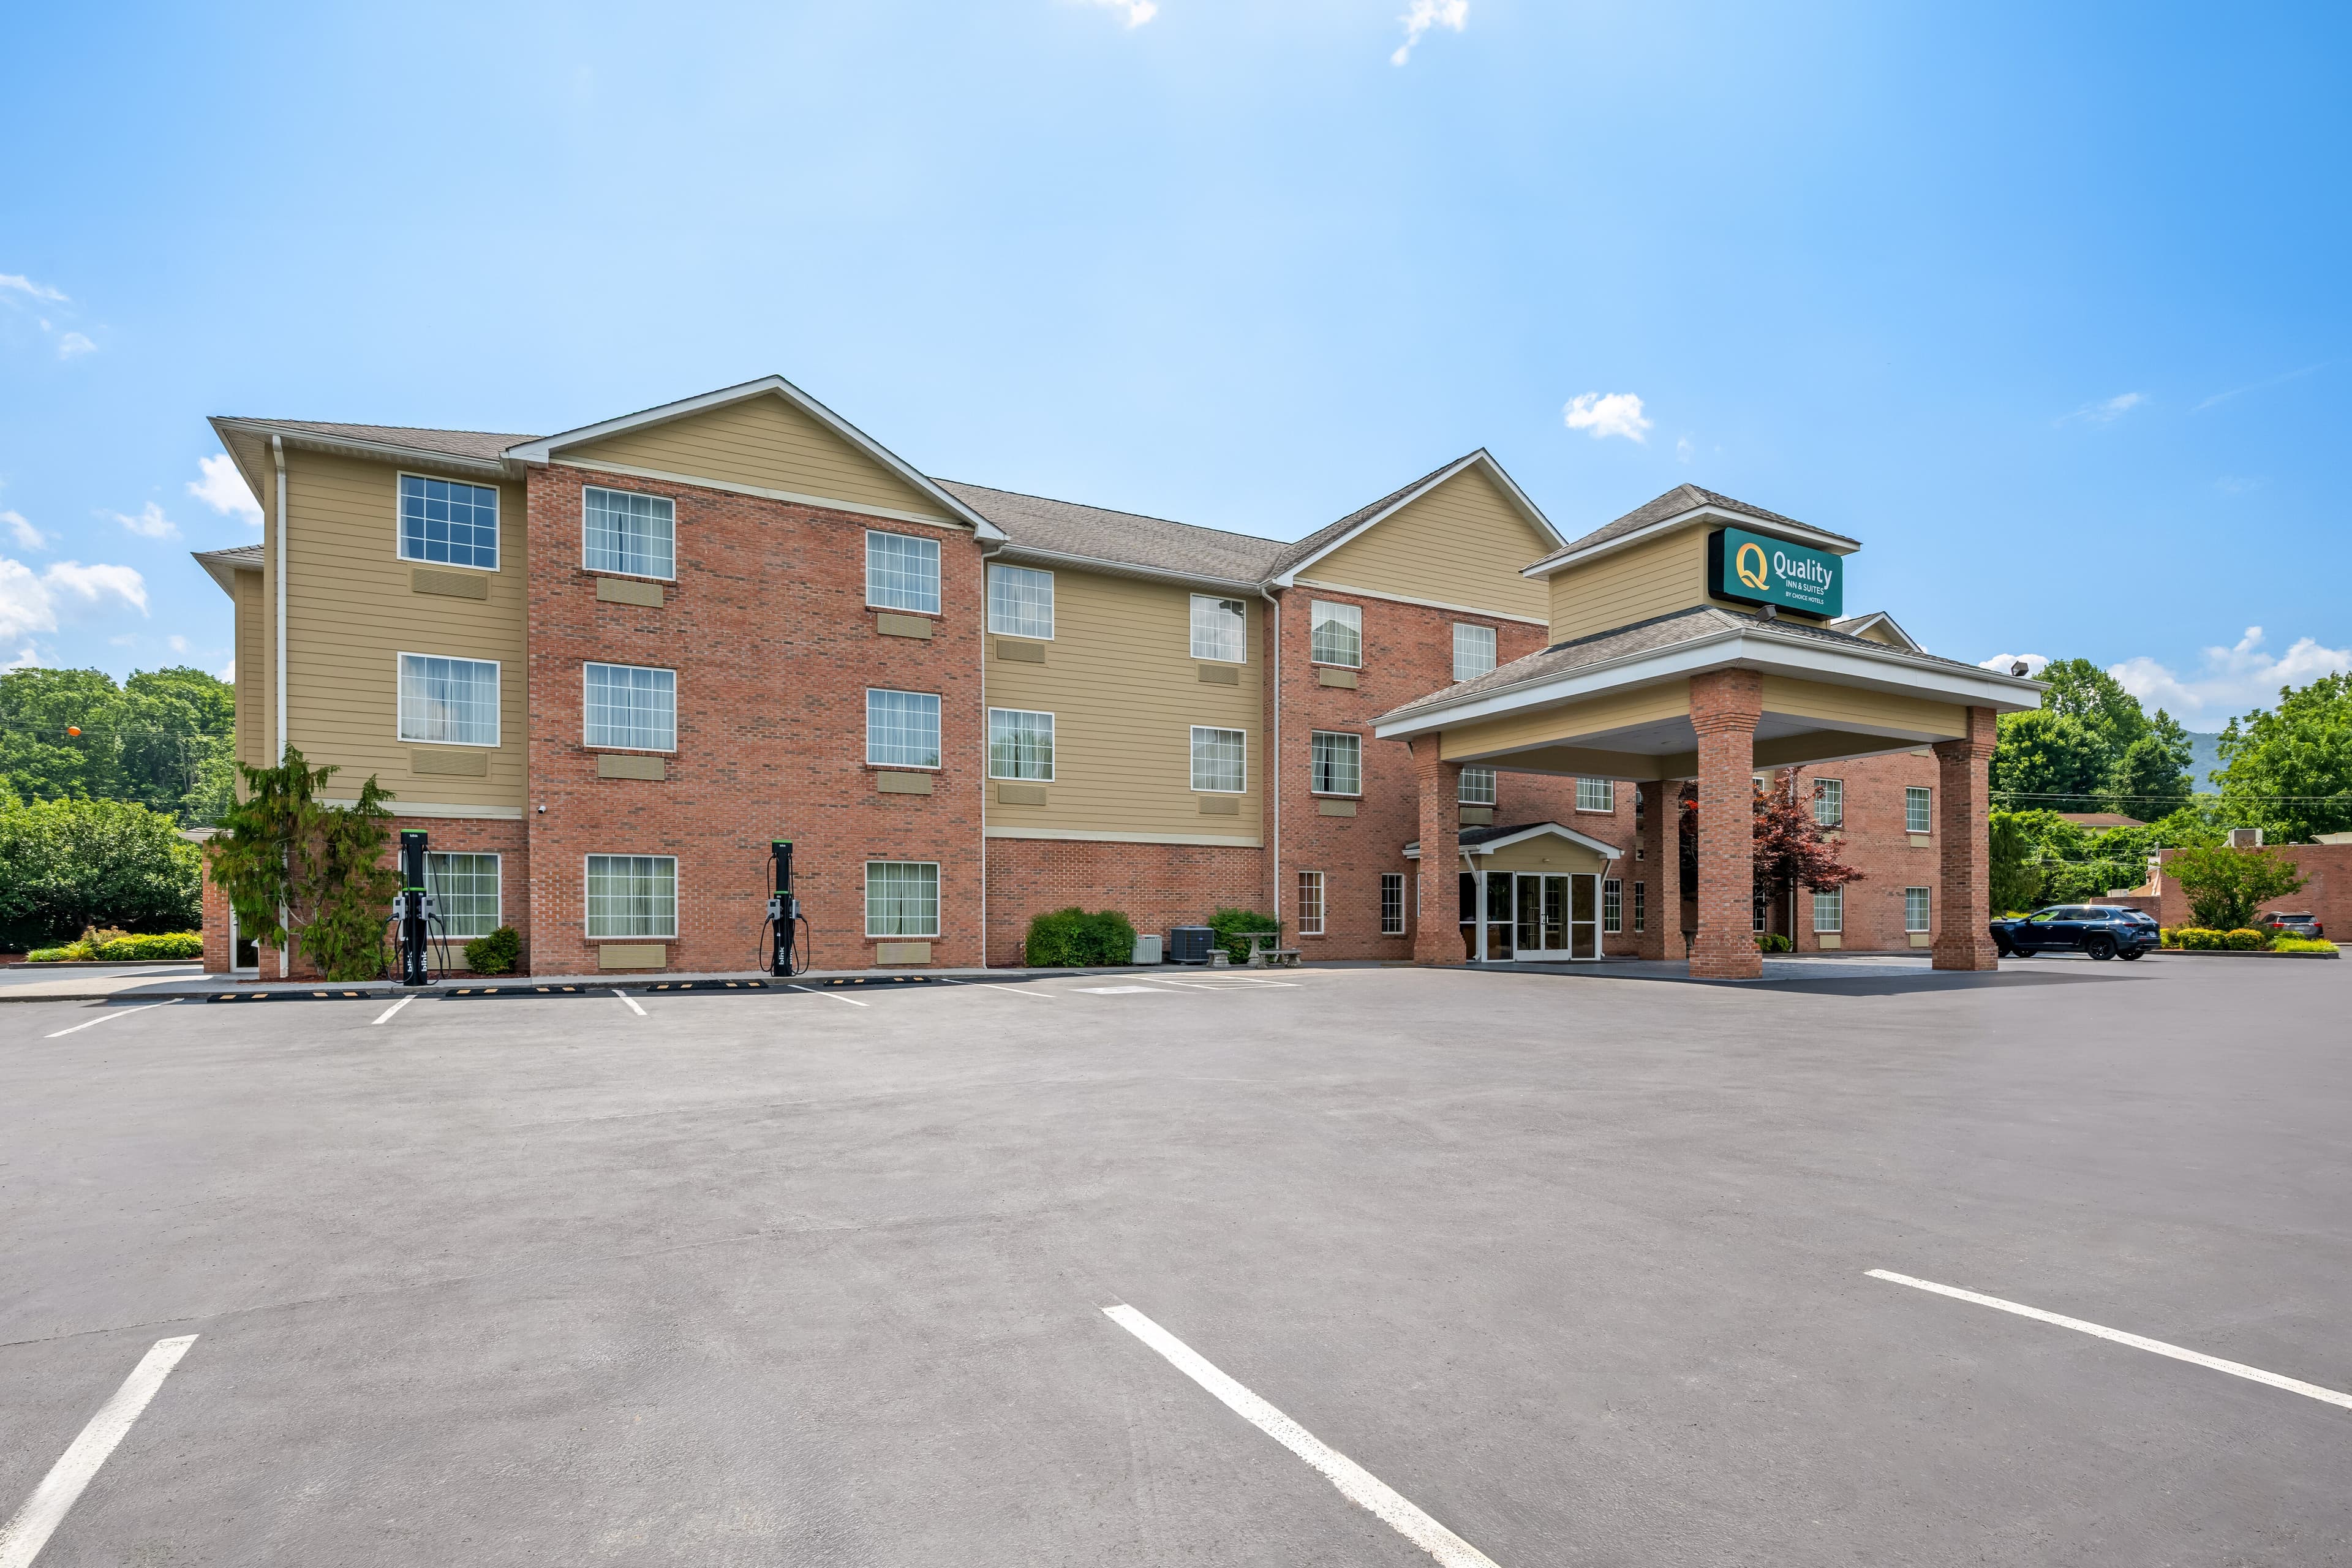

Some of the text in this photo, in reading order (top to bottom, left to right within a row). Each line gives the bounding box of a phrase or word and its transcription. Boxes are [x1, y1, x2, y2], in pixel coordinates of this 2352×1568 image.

[1774, 551, 1833, 590] Quality
[1786, 579, 1797, 589] INN
[1803, 583, 1824, 595] SUITES
[1808, 596, 1824, 605] HOTELS
